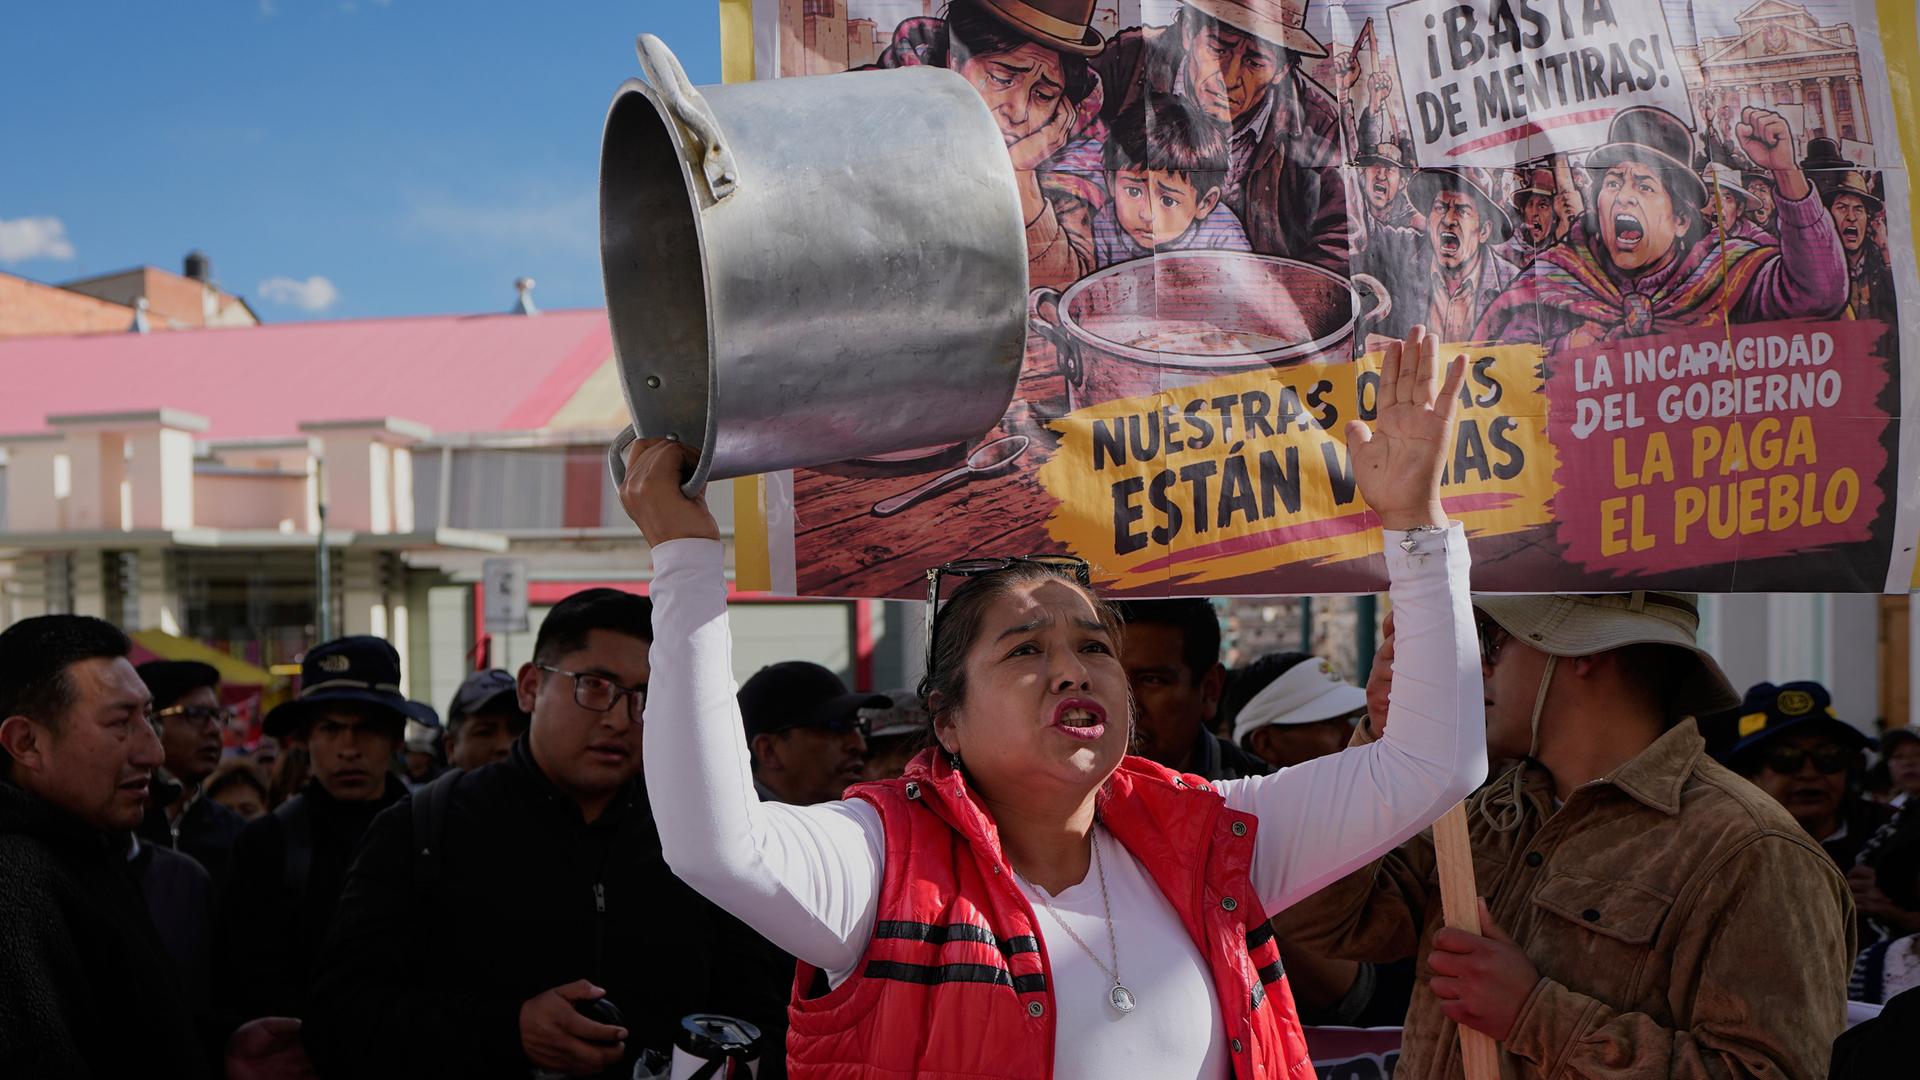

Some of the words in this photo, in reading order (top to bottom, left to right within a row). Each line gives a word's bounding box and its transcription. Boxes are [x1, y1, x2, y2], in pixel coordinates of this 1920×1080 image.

[1415, 82, 1468, 144] DE
[1473, 34, 1670, 128] MENTIRAS!
[1570, 392, 1645, 439] DEL
[1657, 369, 1842, 424] GOBIERNO
[1574, 355, 1614, 392] LA
[1623, 332, 1834, 385] INCAPACIDAD
[1092, 379, 1339, 471] NUESTRAS
[1613, 431, 1675, 489] LA
[1692, 415, 1817, 478] PAGA
[1111, 440, 1300, 555] ESTÁN
[1322, 415, 1525, 506] VAS
[1600, 494, 1656, 557] EL
[1674, 467, 1860, 545] PUEBLO
